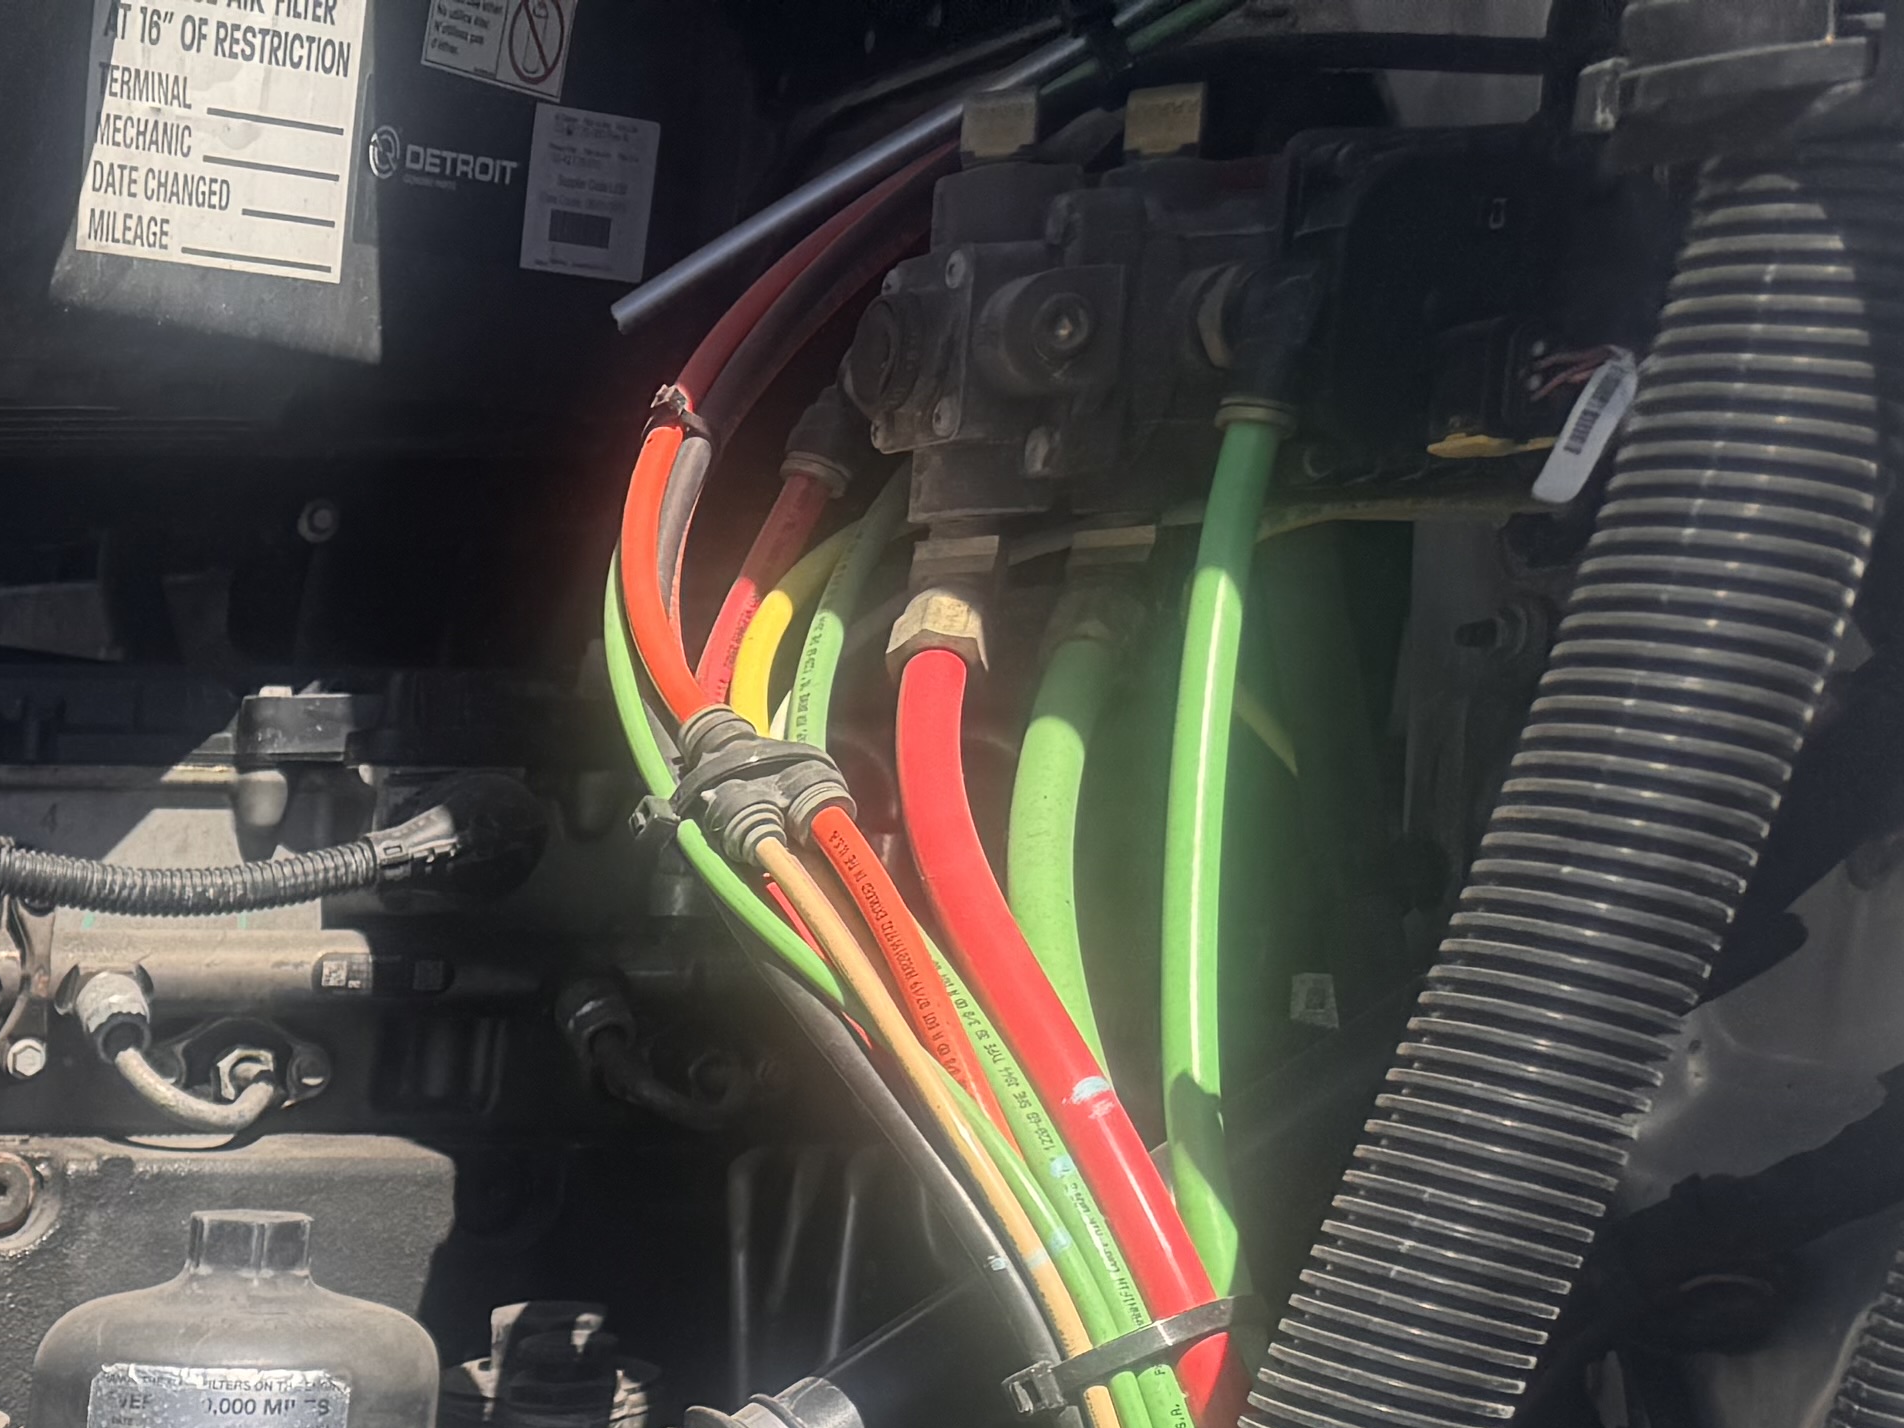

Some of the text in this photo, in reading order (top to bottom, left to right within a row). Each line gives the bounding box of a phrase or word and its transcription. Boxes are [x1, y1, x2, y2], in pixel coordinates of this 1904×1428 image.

[103, 4, 132, 40] AT
[180, 14, 208, 54] OF
[213, 22, 351, 78] RESTRICTION
[99, 61, 193, 110] TERMINAL
[97, 113, 193, 158] MECHANIC
[91, 159, 231, 211] DATE CHANGED
[406, 144, 519, 185] DETROIT
[88, 209, 170, 251] MILEAGE
[255, 1381, 274, 1391] ON
